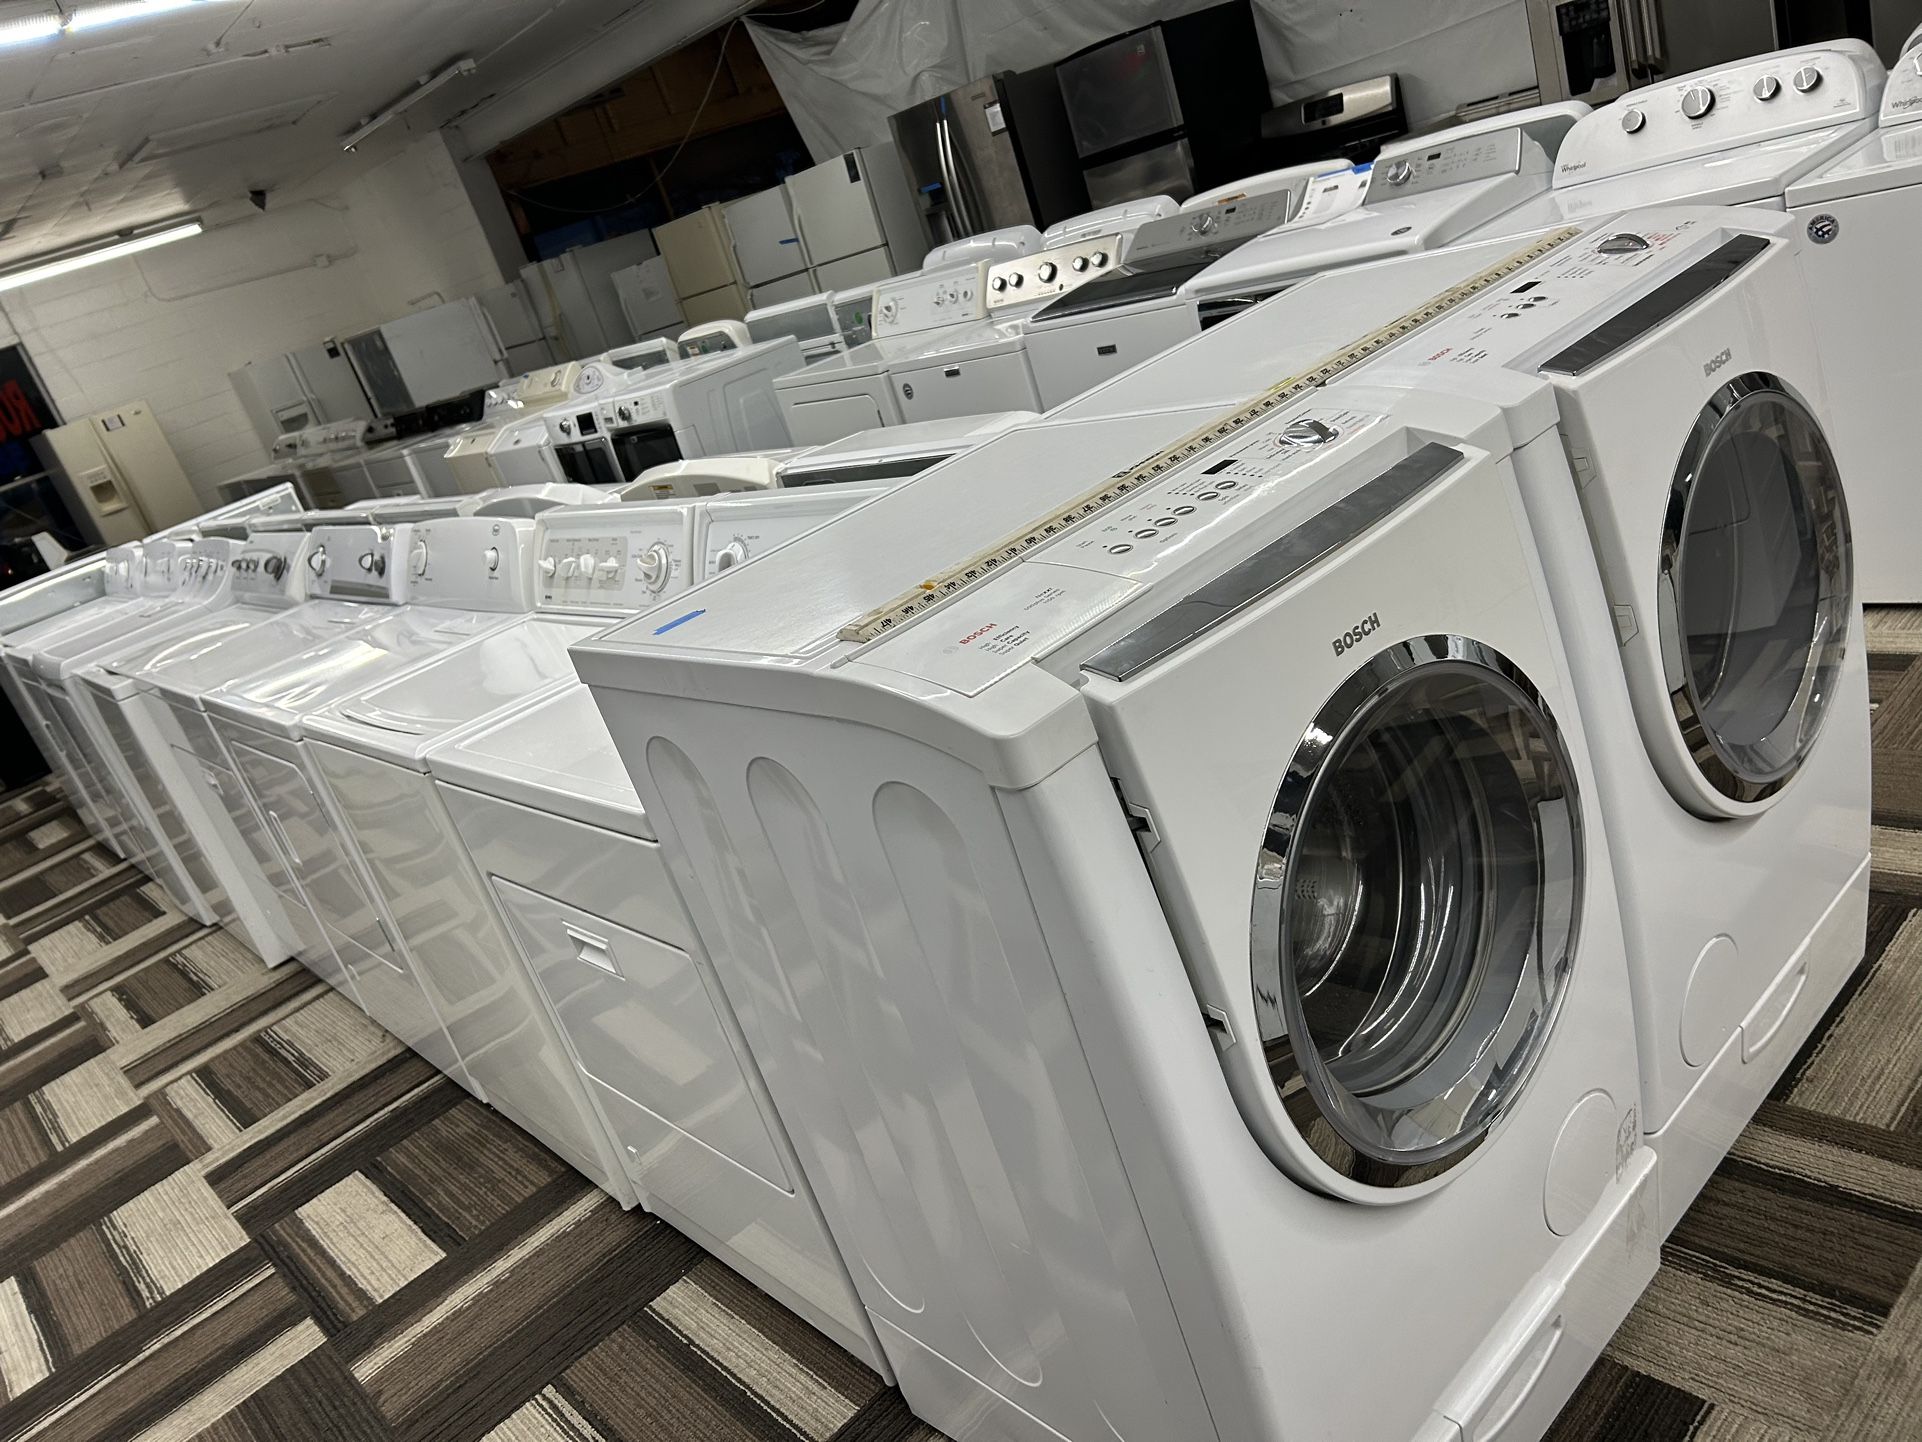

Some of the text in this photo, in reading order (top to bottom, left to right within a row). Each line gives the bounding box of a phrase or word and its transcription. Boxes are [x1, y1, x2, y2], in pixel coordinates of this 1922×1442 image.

[1703, 347, 1732, 378] BOSCH
[1024, 536, 1037, 545] 40
[1005, 547, 1018, 556] 41
[984, 558, 998, 568] 42
[965, 569, 978, 580] 43
[944, 581, 957, 591] 44
[923, 593, 935, 604] 45
[901, 605, 915, 616] 46
[880, 618, 893, 629] 47
[959, 622, 998, 645] BOSCH
[992, 625, 1020, 641] Efficiency
[1006, 630, 1030, 645] Capacity
[1331, 612, 1381, 657] BOSCH
